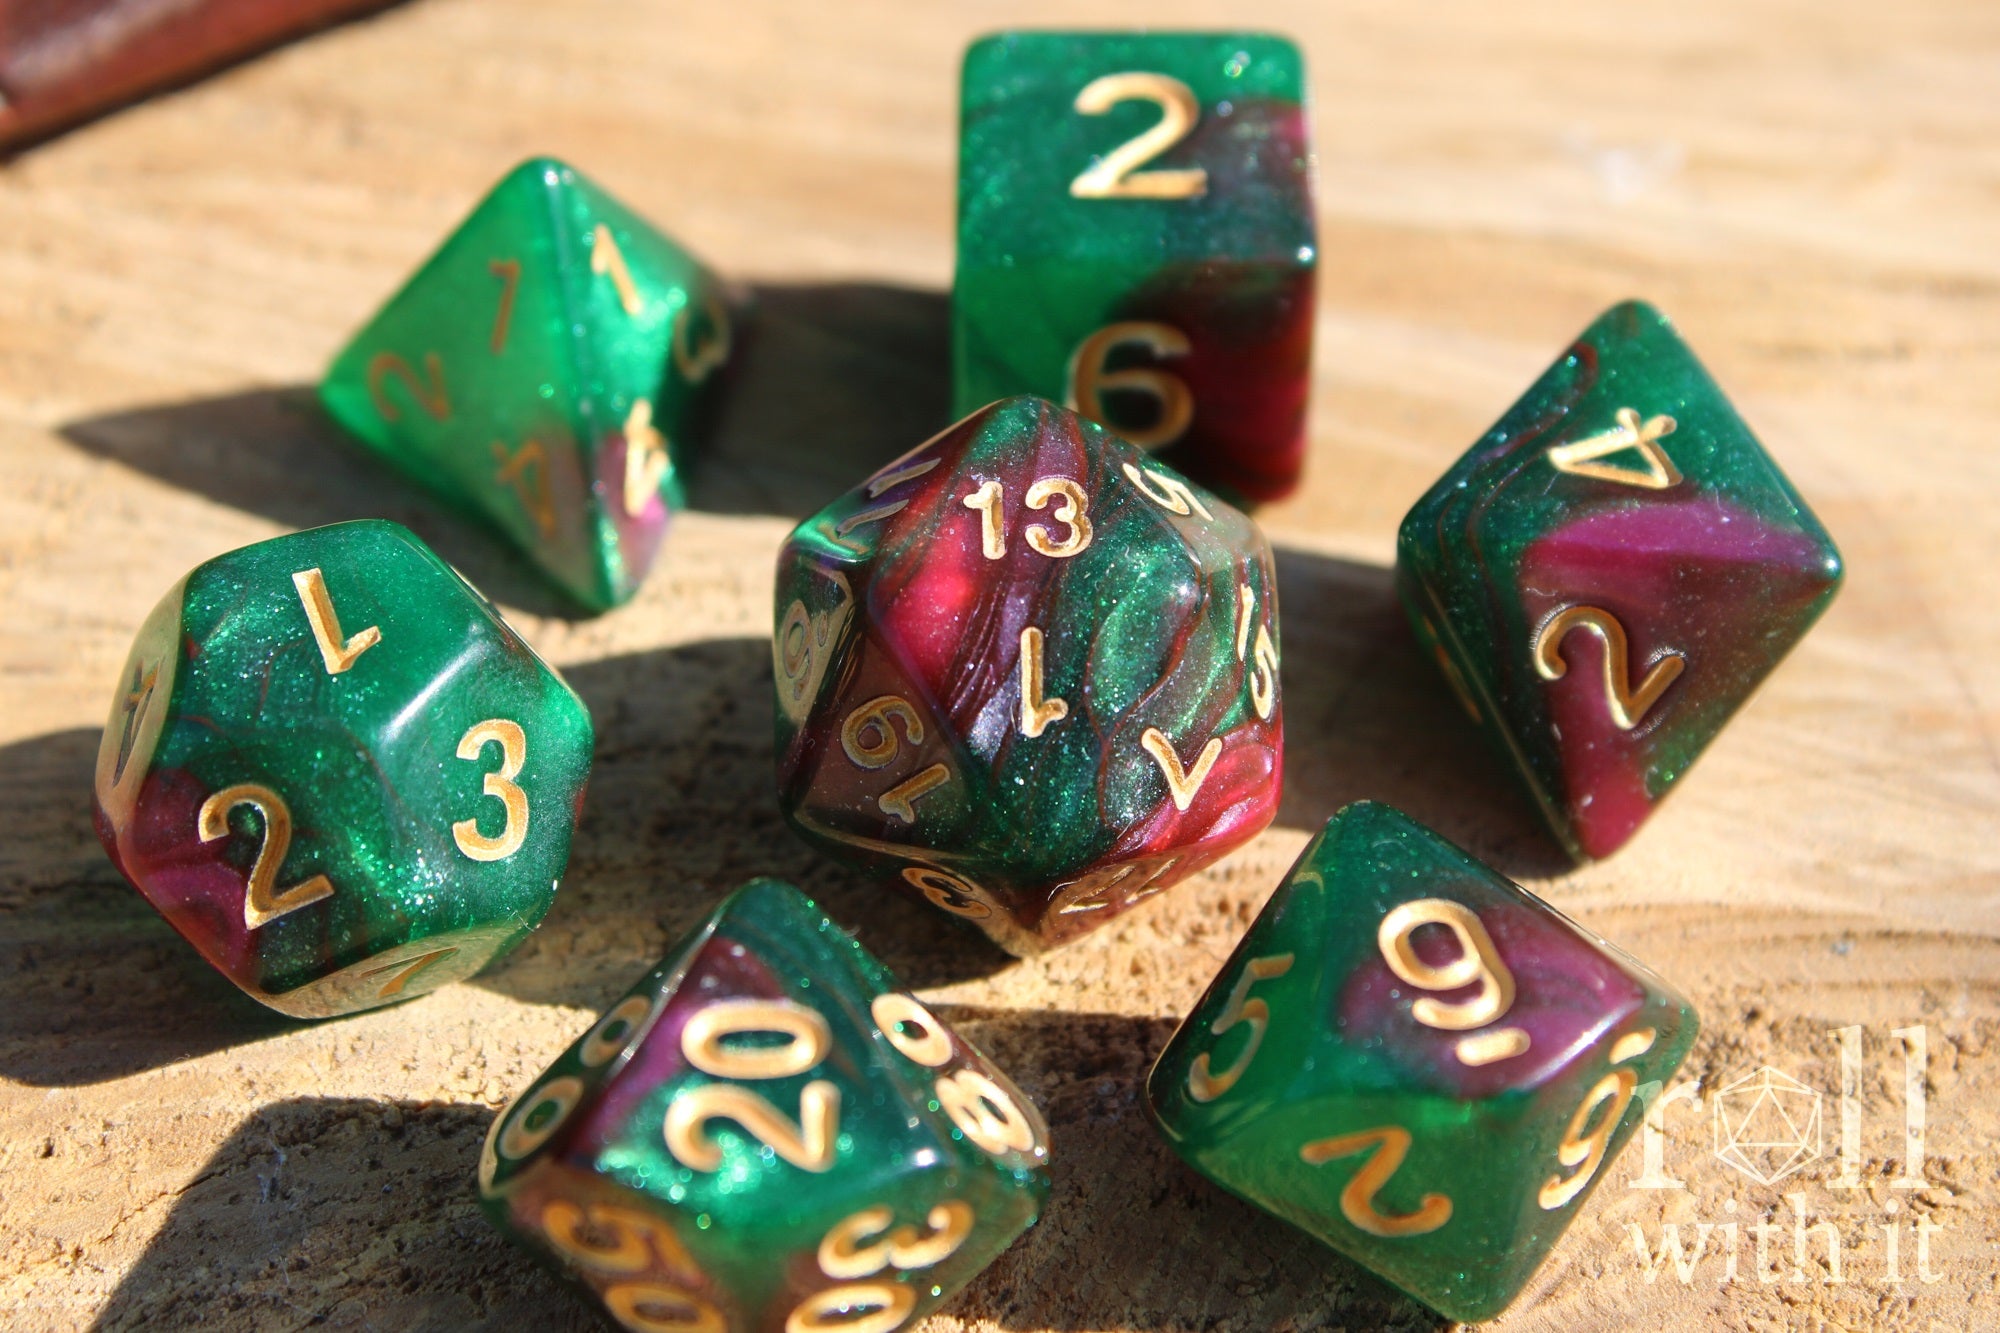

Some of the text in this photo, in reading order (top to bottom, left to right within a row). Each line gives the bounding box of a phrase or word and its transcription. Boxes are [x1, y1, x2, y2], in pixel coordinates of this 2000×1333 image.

[1069, 71, 1208, 198] 2
[489, 259, 520, 353] 1
[591, 223, 644, 315] 1
[366, 352, 452, 422] 2
[1068, 321, 1197, 447] 6
[1548, 407, 1677, 489] 4
[963, 476, 1093, 560] 13
[292, 567, 382, 674] 1
[1531, 604, 1687, 730] 2
[1020, 626, 1068, 738] 1
[452, 718, 529, 862] 3
[198, 784, 335, 930] 2
[870, 993, 1036, 1154] 80
[1188, 952, 1295, 1102] 5
[663, 1001, 840, 1174] 20
[1301, 1126, 1453, 1237] 2
